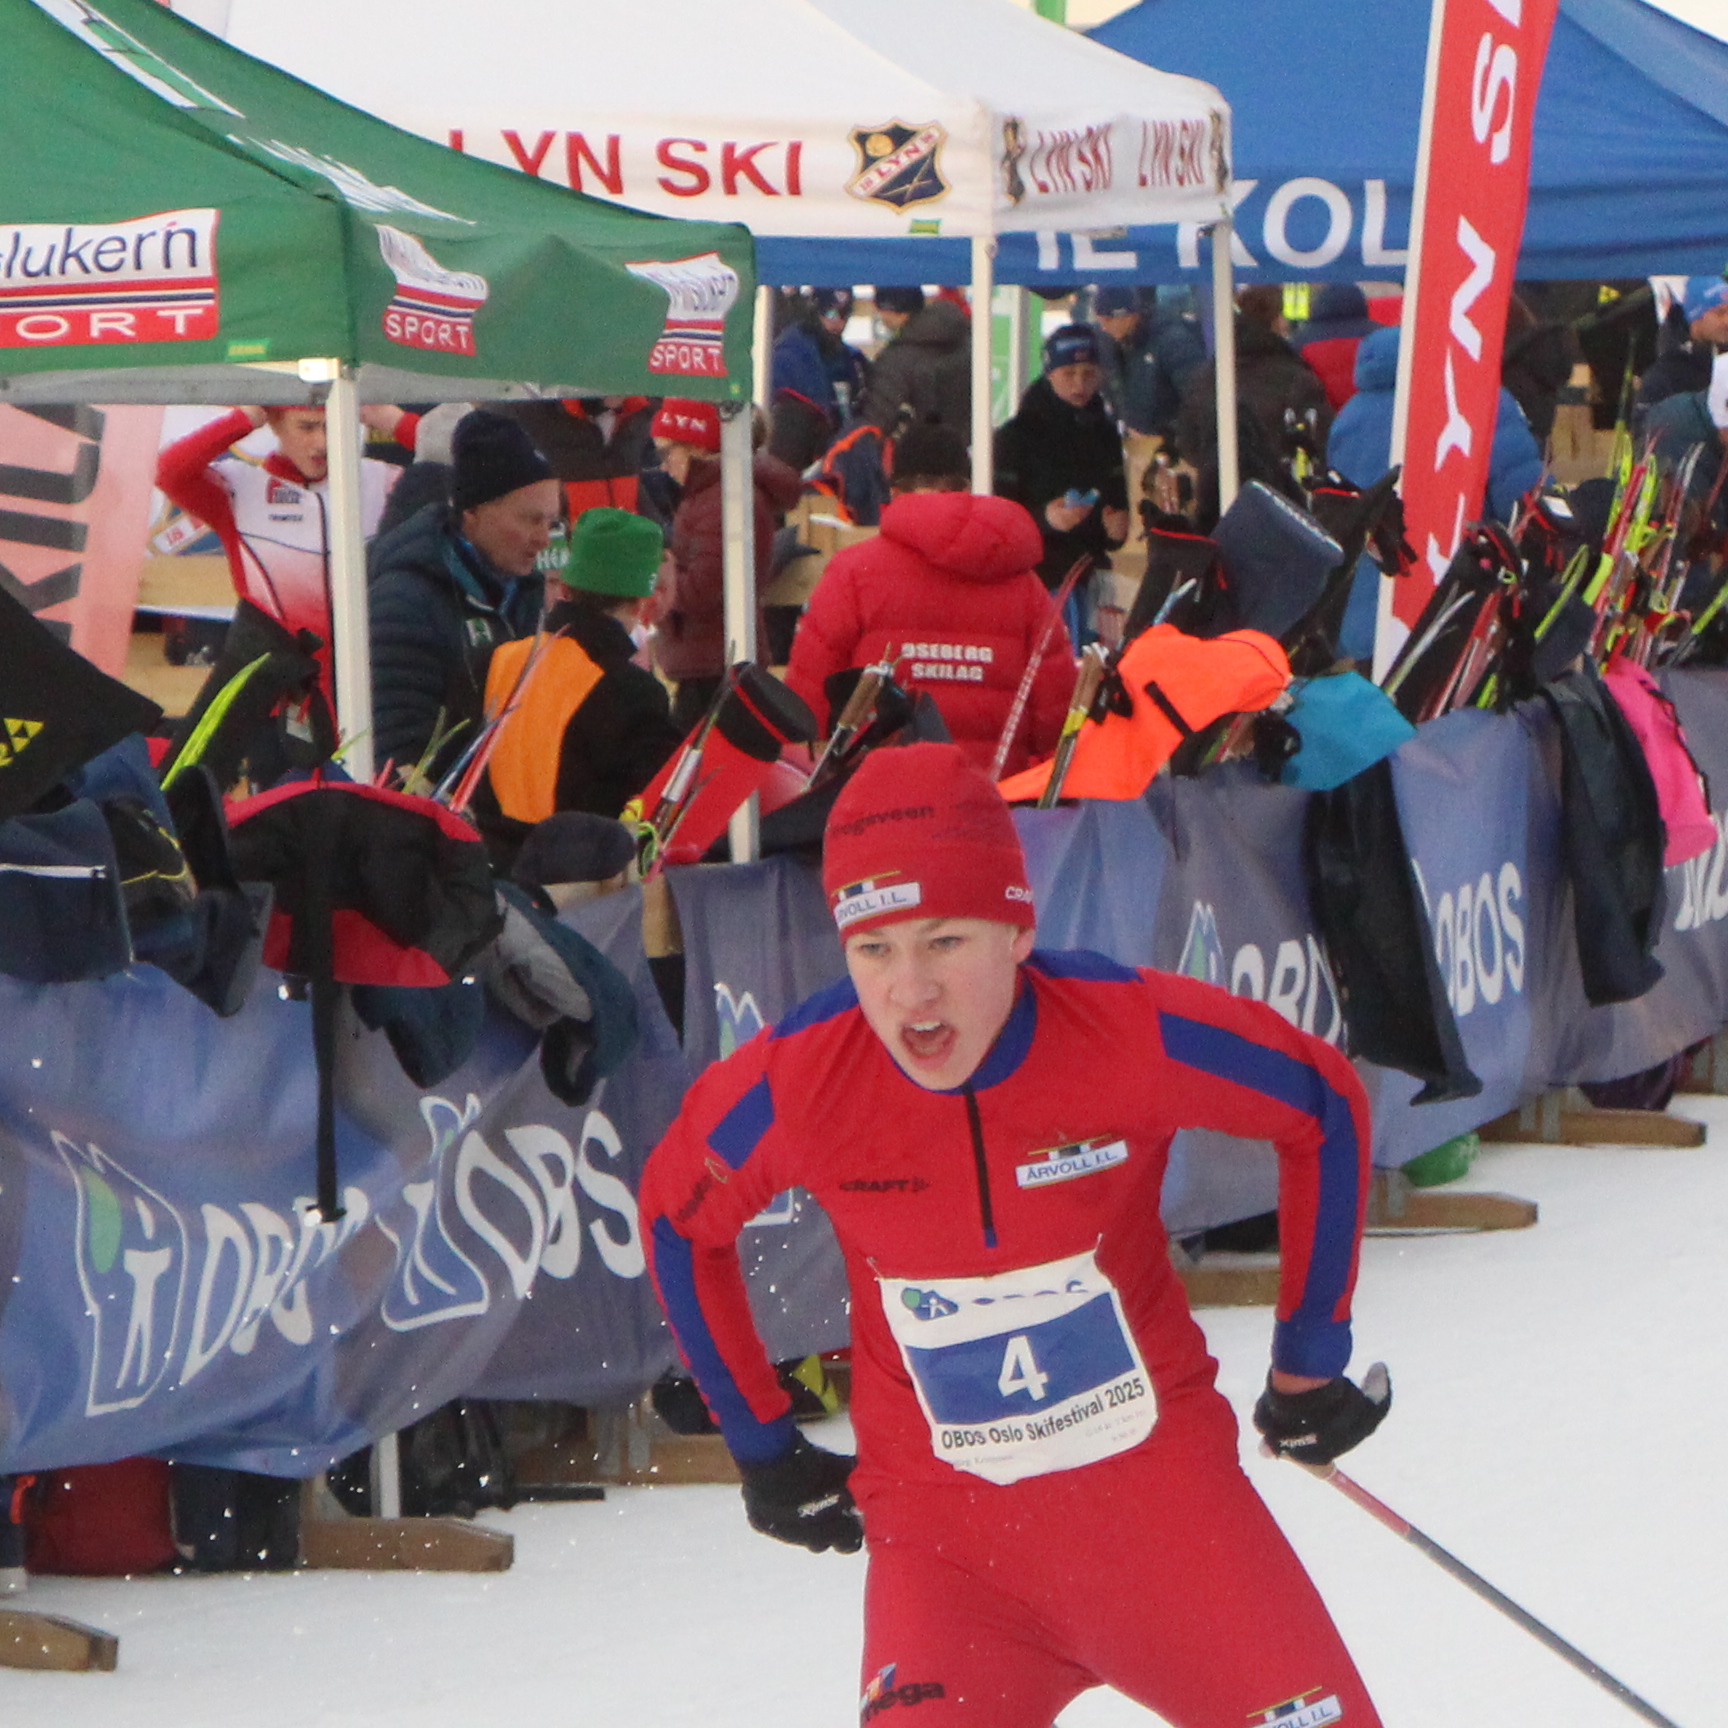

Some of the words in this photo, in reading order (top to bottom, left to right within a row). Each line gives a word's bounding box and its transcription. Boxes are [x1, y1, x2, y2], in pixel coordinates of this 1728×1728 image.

[656, 139, 802, 197] SKI
[384, 312, 470, 350] SPORT
[650, 343, 722, 371] SPORT
[661, 411, 708, 433] LYN
[1435, 861, 1526, 1016] OBOS
[1026, 1157, 1092, 1182] ÅRVOLL
[997, 1334, 1049, 1402] 4
[941, 1429, 986, 1452] OBOS
[989, 1422, 1023, 1445] Oslo
[1026, 1398, 1105, 1442] Skifestival
[1105, 1377, 1146, 1411] 2025
